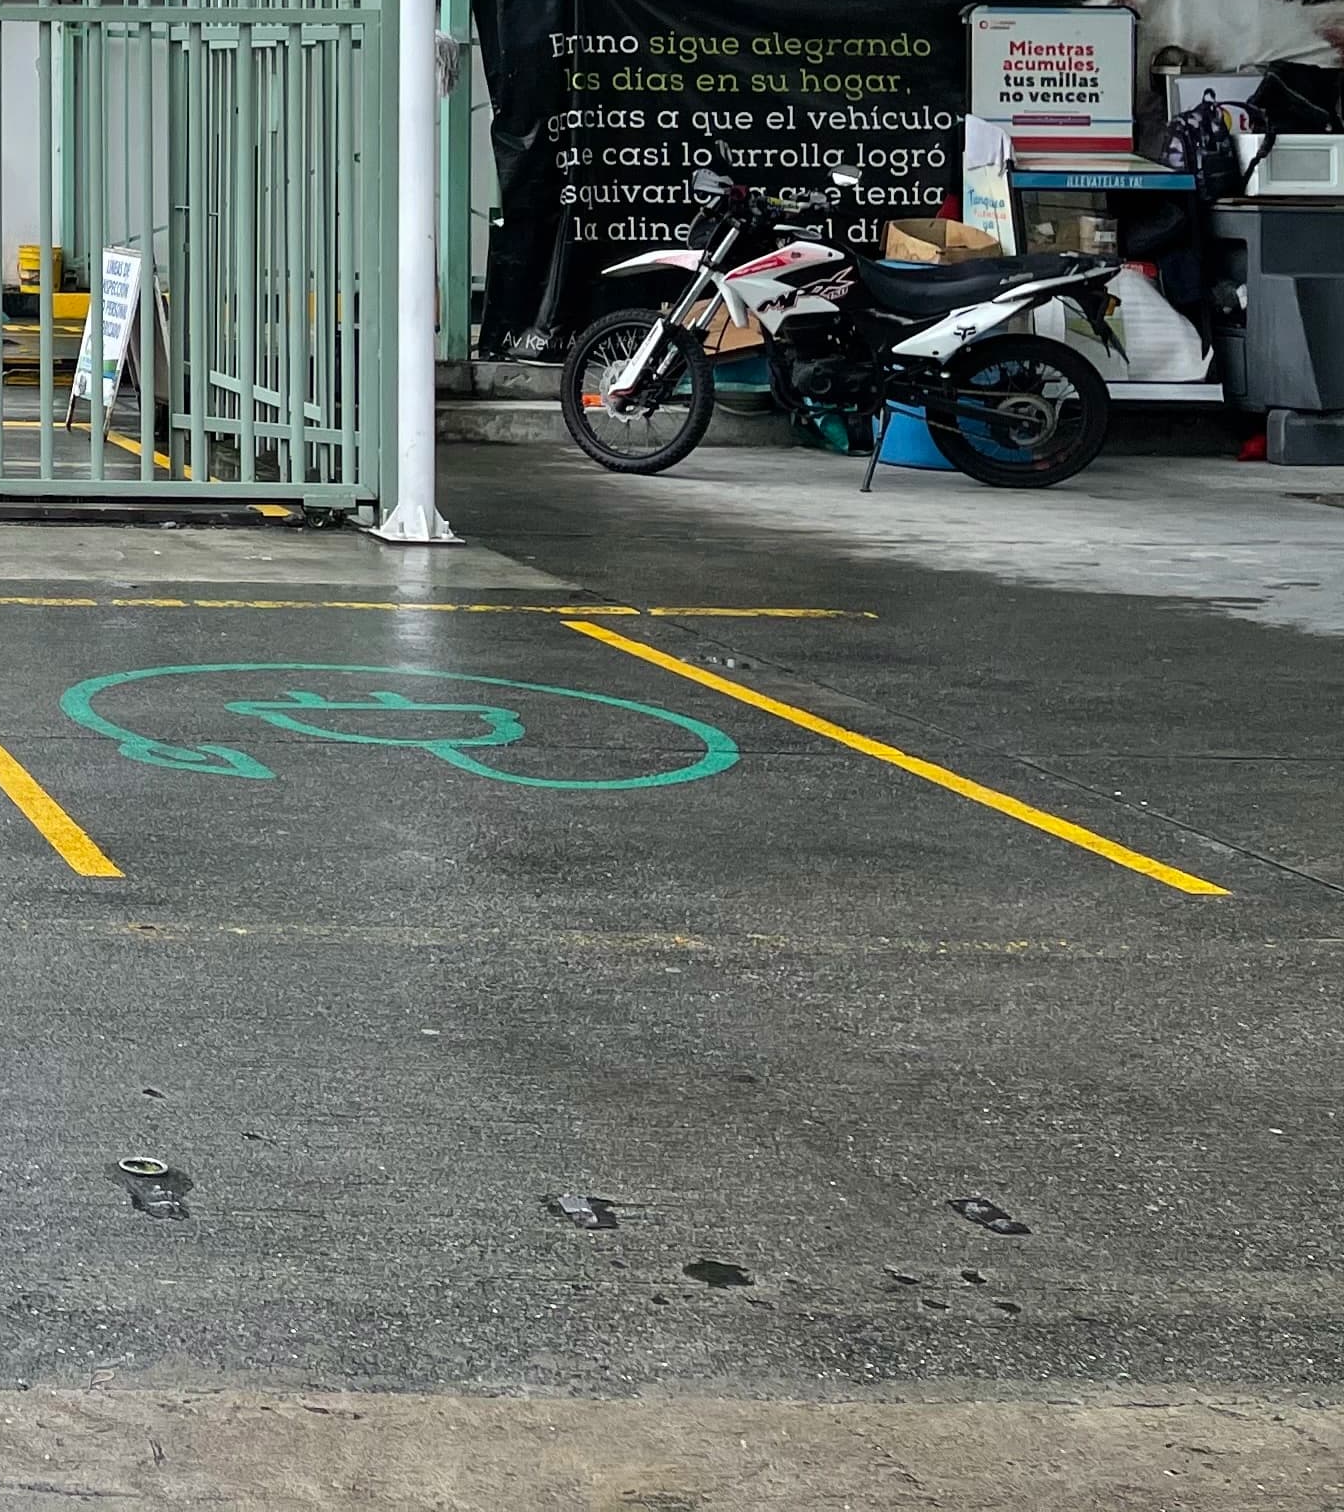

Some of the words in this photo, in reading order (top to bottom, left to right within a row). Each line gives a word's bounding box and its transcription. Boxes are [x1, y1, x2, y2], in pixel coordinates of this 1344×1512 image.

[549, 33, 639, 58] Bruno
[649, 31, 739, 63] sigue
[752, 32, 931, 64] alegrando
[1009, 40, 1094, 57] Mientras
[1003, 57, 1100, 73] acumules,
[612, 67, 685, 92] días
[696, 73, 740, 92] en
[751, 73, 790, 93] su
[799, 68, 911, 101] hogar,
[1004, 74, 1035, 88] tus
[1040, 72, 1099, 88] millas
[999, 91, 1024, 104] no
[548, 104, 646, 142] gracias
[657, 110, 679, 128] a
[692, 110, 754, 137] que
[766, 105, 796, 130] el
[807, 105, 952, 130] vehículo
[602, 142, 671, 167] casi
[682, 142, 713, 167] lo
[857, 143, 946, 177] logró
[856, 181, 945, 206] tenía
[574, 216, 598, 241] la
[847, 218, 879, 243] dí
